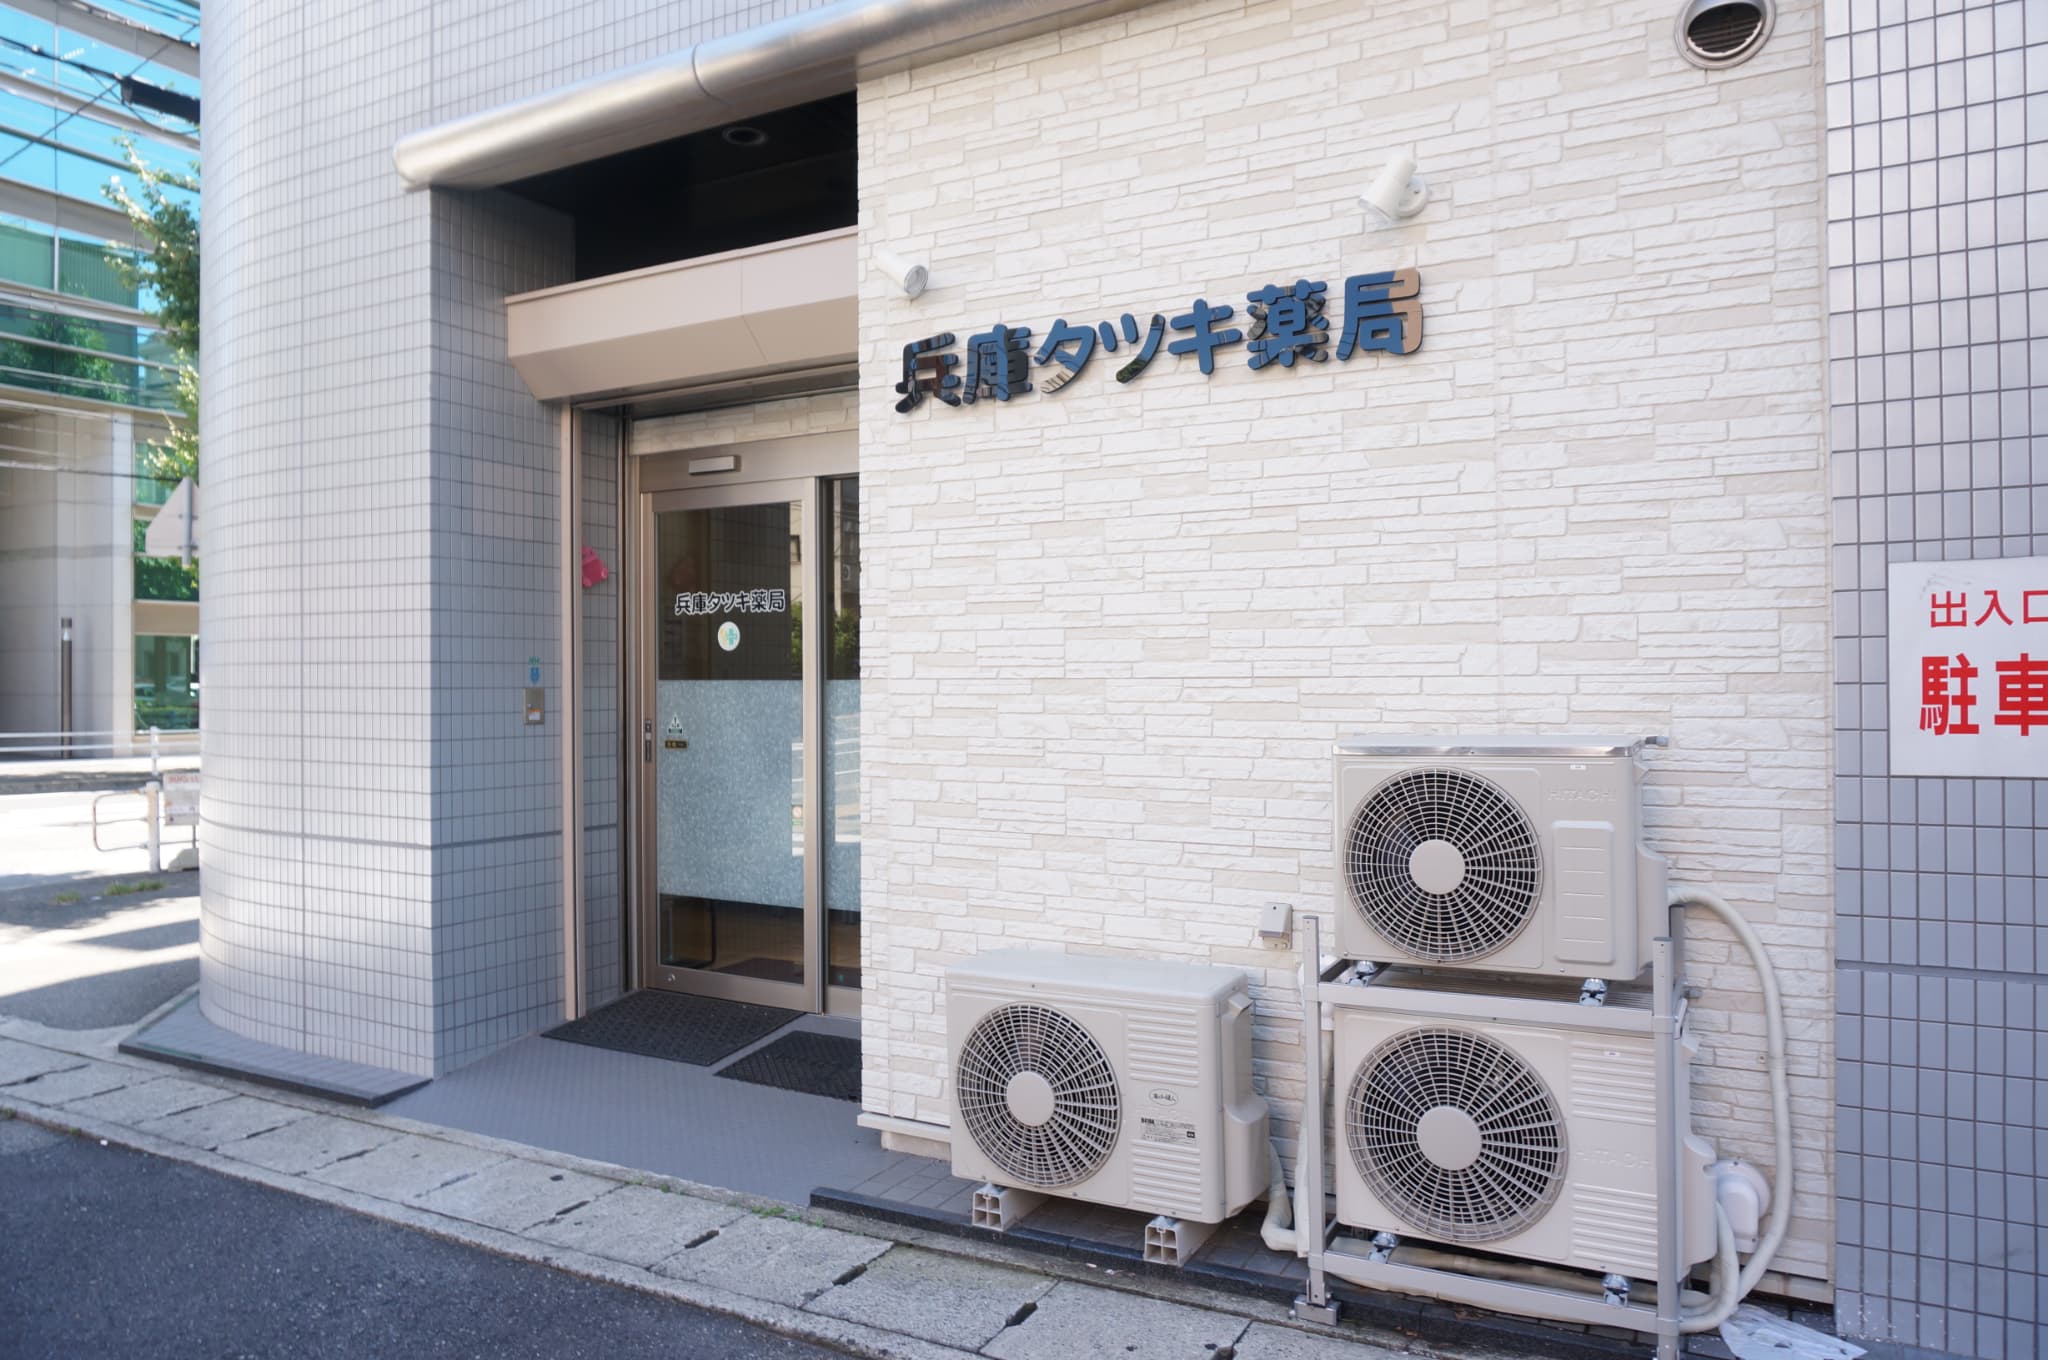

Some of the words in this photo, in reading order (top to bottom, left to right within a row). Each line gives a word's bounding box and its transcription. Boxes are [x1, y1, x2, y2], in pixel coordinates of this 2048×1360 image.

[895, 267, 1423, 414] 兵庫タツキ薬局
[675, 589, 786, 616] 兵庫タツキ薬局
[1930, 589, 2048, 628] 出入口
[1919, 653, 2048, 737] 駐車
[1547, 786, 1617, 802] HITACHI
